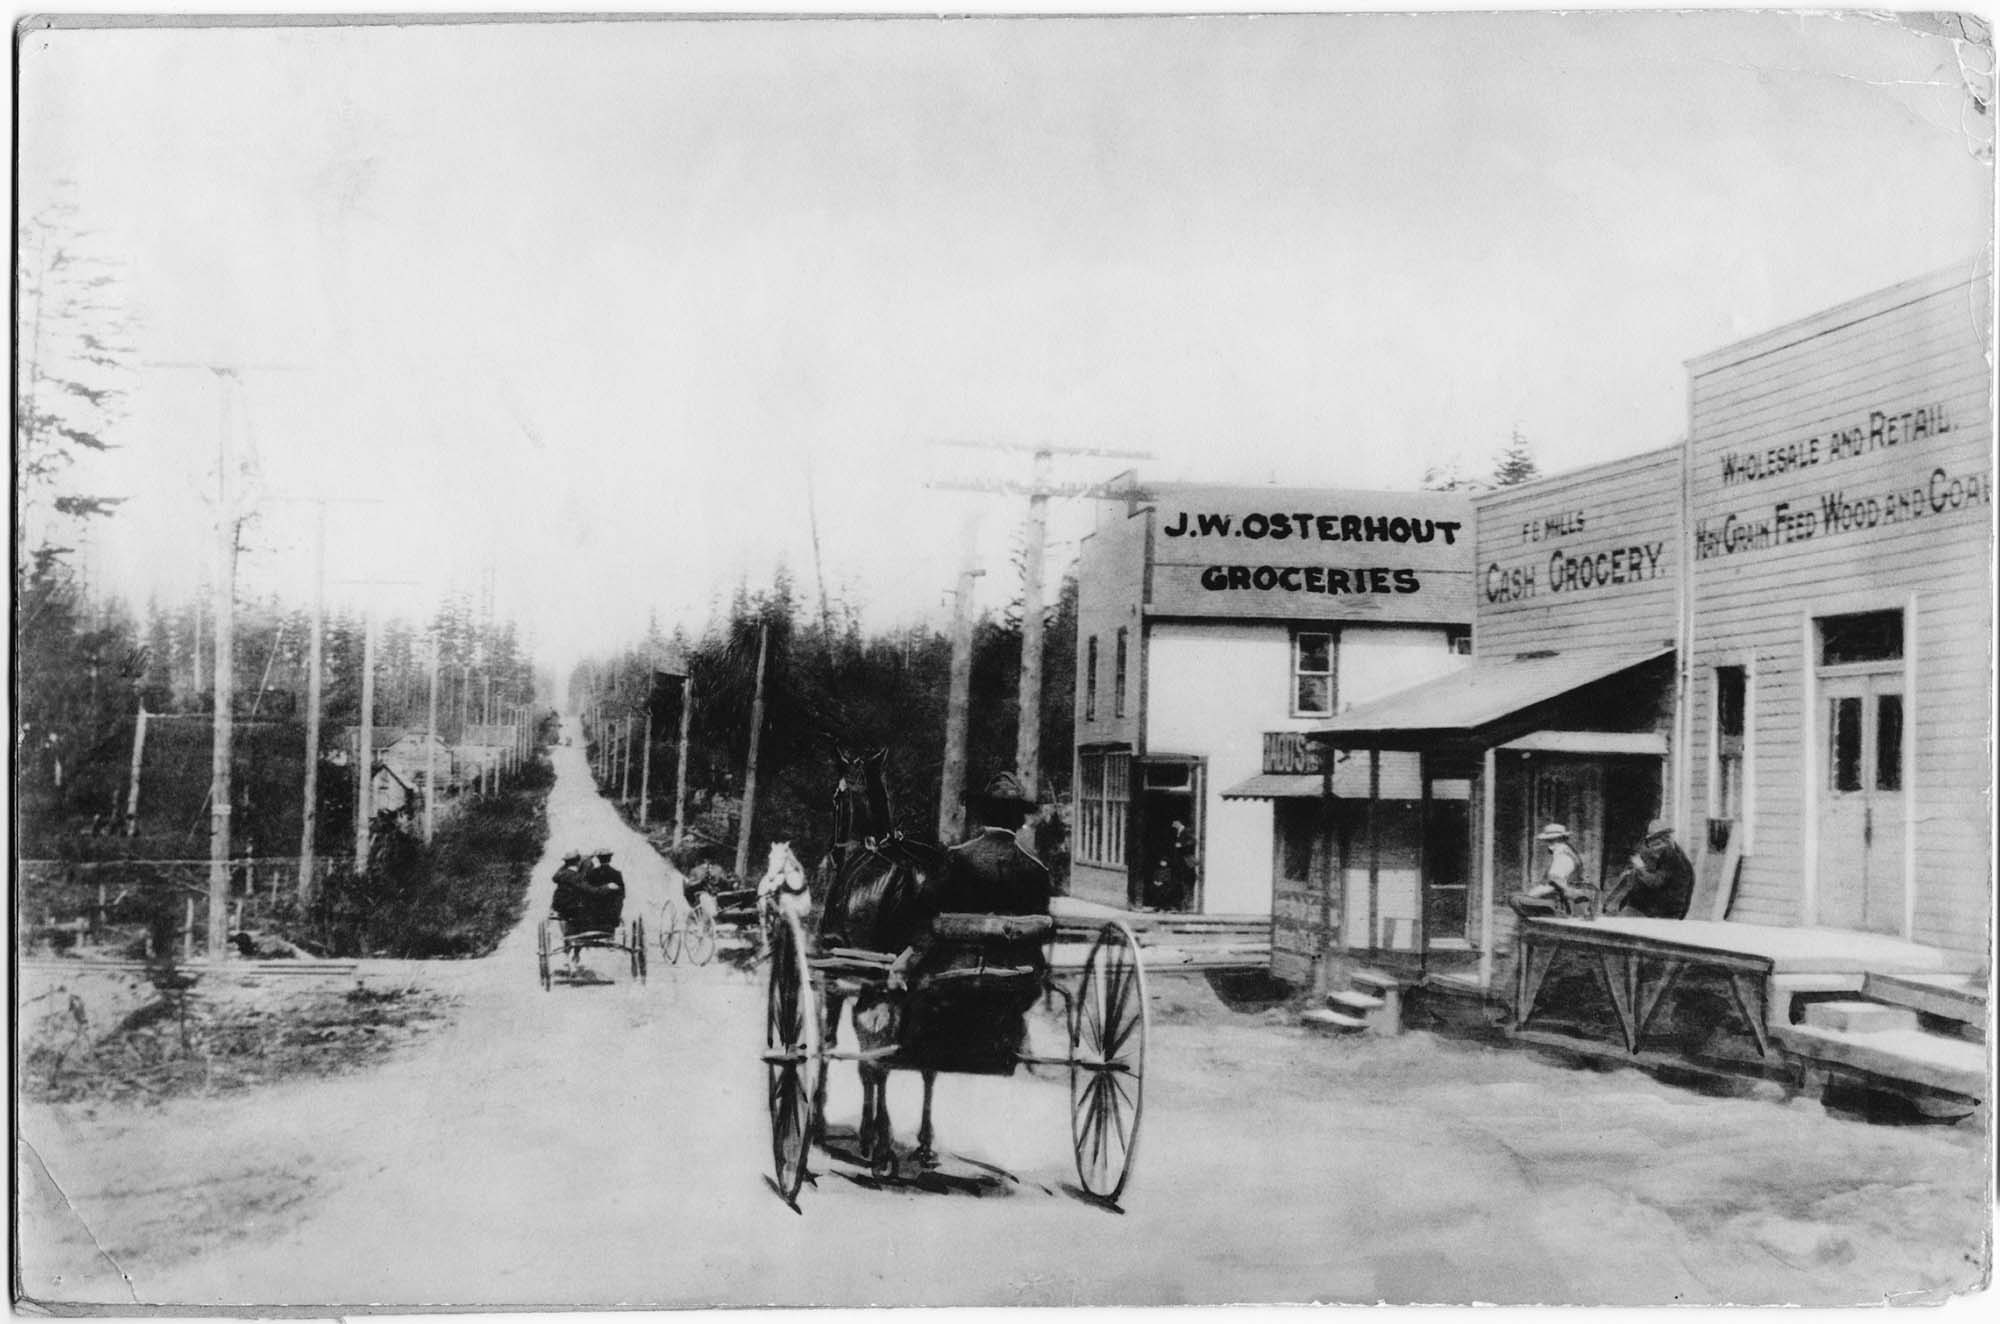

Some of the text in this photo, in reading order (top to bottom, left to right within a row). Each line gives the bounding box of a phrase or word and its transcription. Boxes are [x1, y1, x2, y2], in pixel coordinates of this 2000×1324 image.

[1721, 438, 1820, 486] WHOLESALE
[1830, 427, 1863, 460] AND
[1724, 513, 1770, 554] GRAIN
[1775, 502, 1817, 545] FEED
[1821, 490, 1880, 535] WOOD
[1885, 488, 1925, 526] AND
[1200, 565, 1421, 595] GROCERIES
[1486, 562, 1537, 604] CASH
